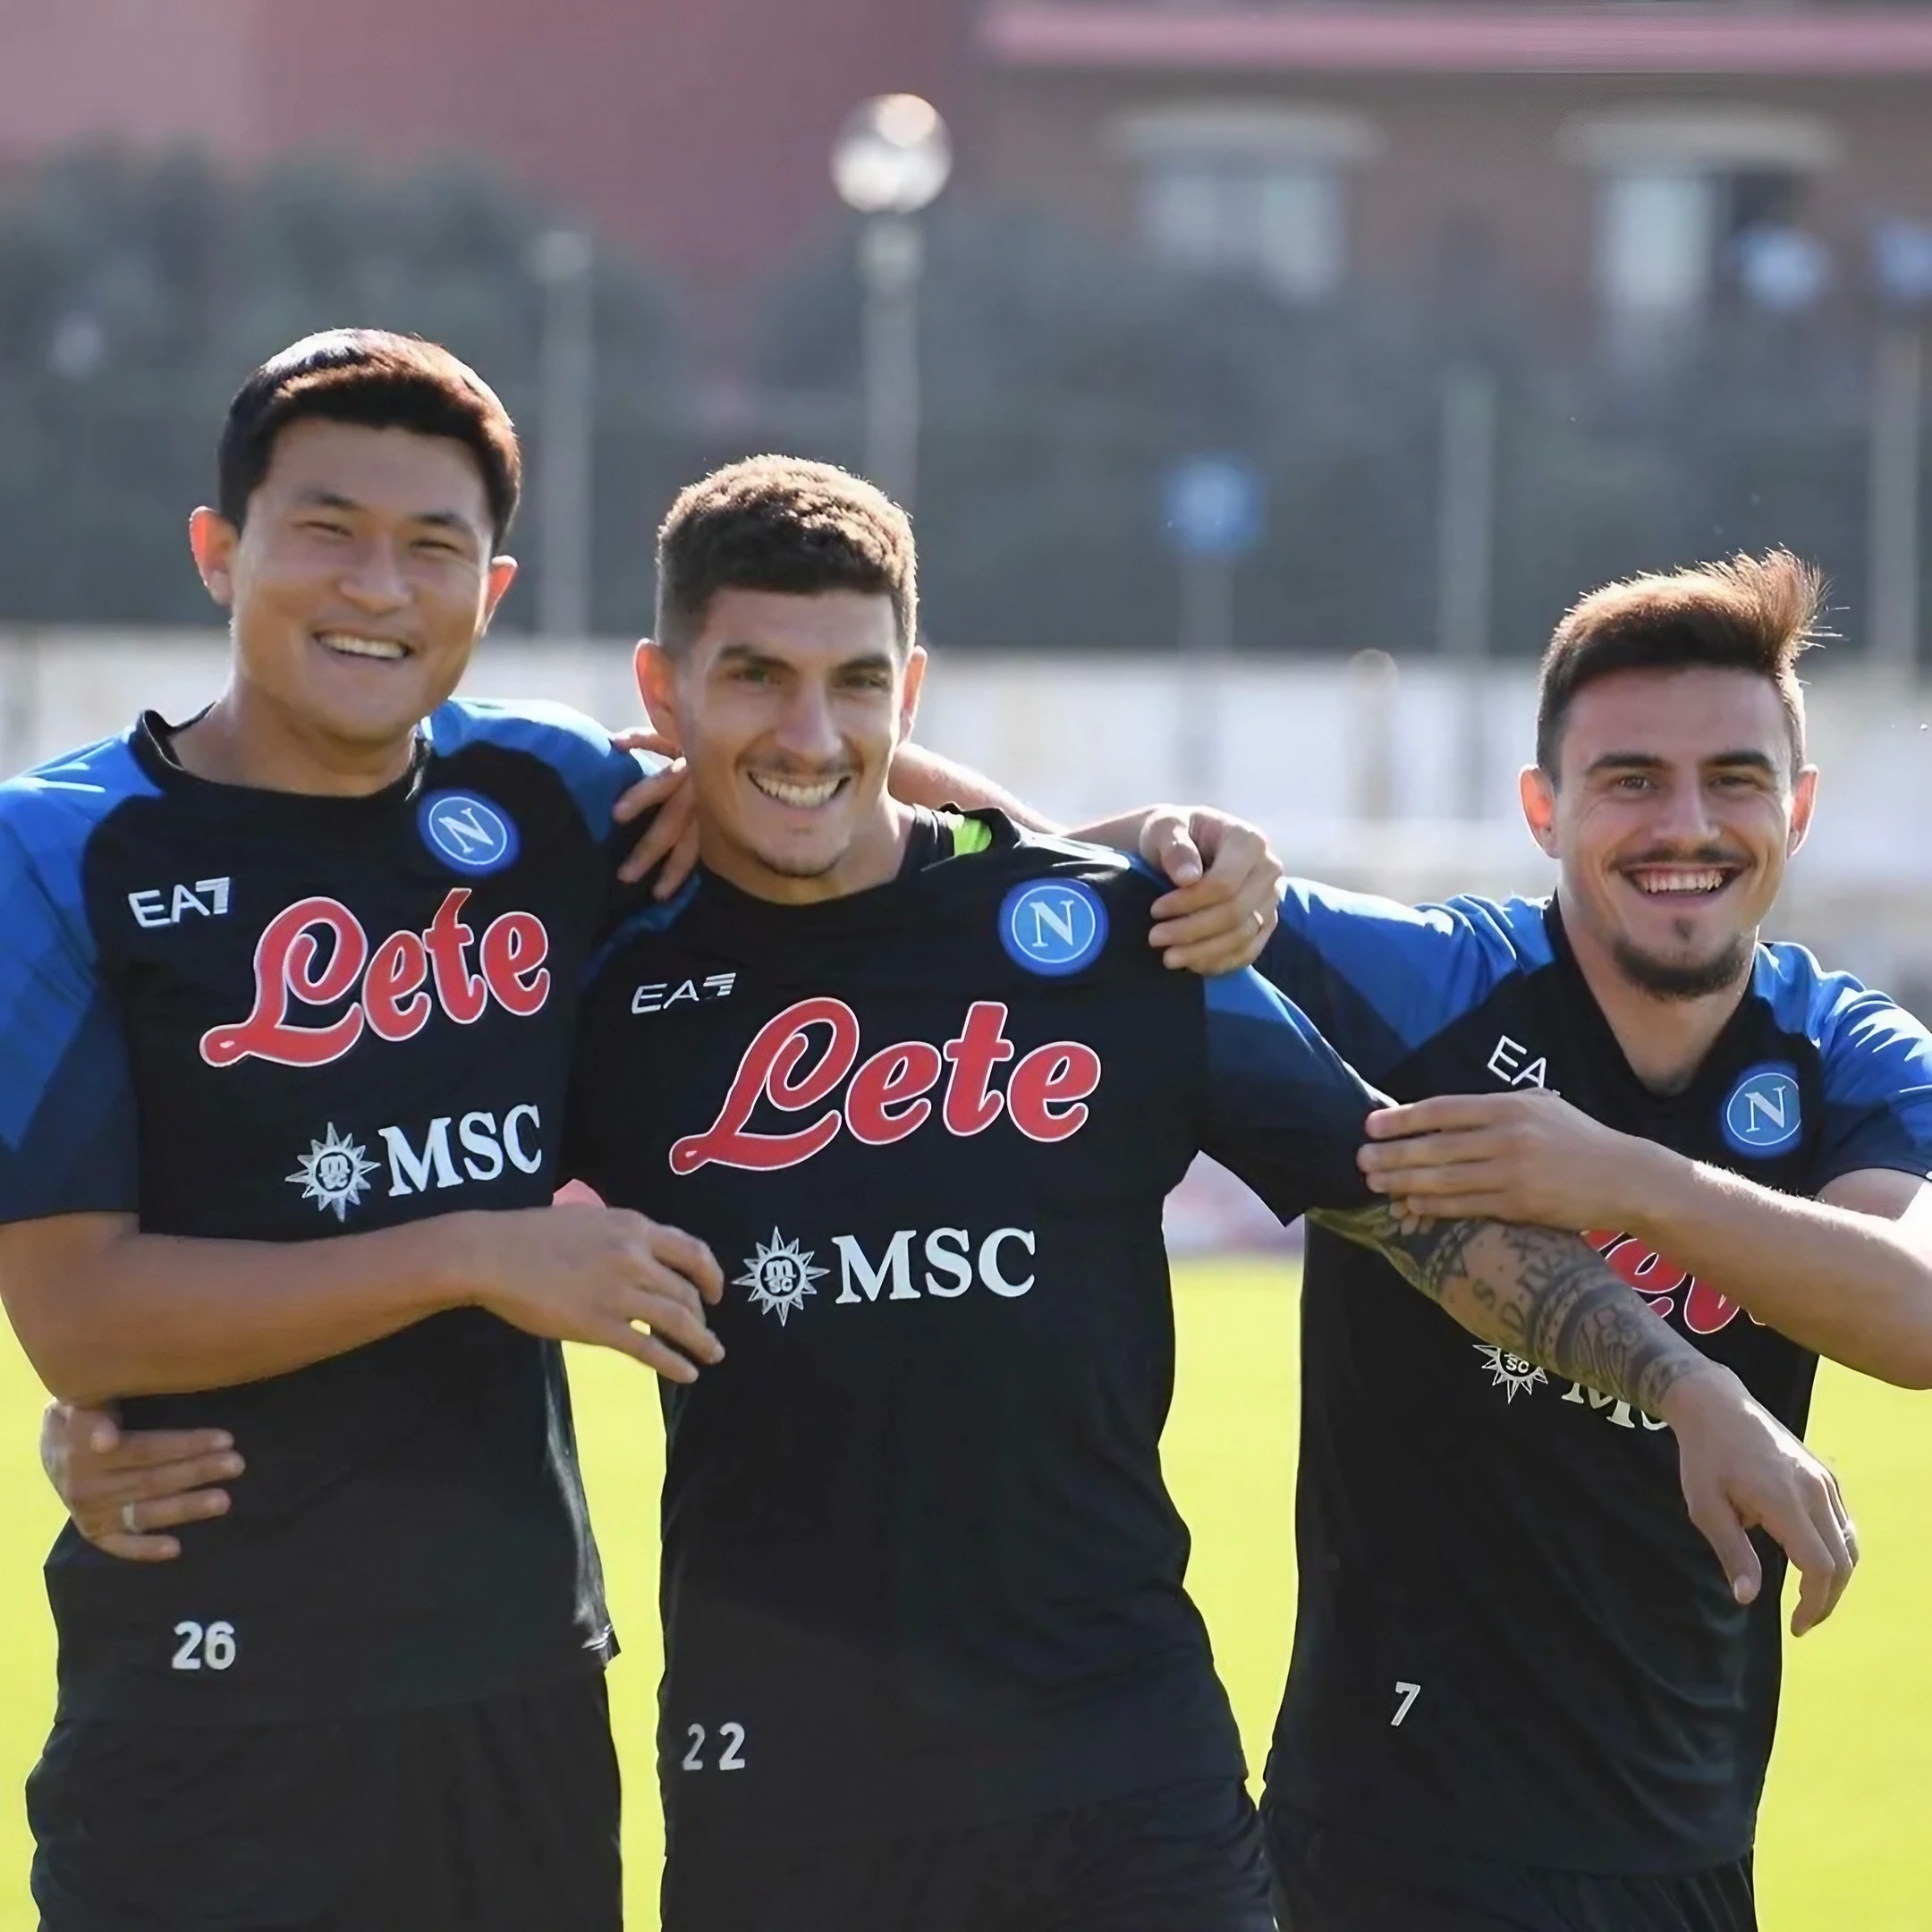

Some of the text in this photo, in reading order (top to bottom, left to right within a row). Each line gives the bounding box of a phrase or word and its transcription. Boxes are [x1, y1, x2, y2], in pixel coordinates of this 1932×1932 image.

[438, 807, 495, 854] N
[128, 877, 231, 928] EA7
[1029, 900, 1075, 948] N
[199, 887, 551, 1068] Lete
[631, 972, 737, 1014] EA7
[668, 996, 1102, 1176] Lete
[1744, 1086, 1786, 1132] N
[378, 1104, 542, 1197] MSC
[830, 1226, 1037, 1305] MSC
[172, 1621, 236, 1670] 26
[1390, 1681, 1421, 1726] 7
